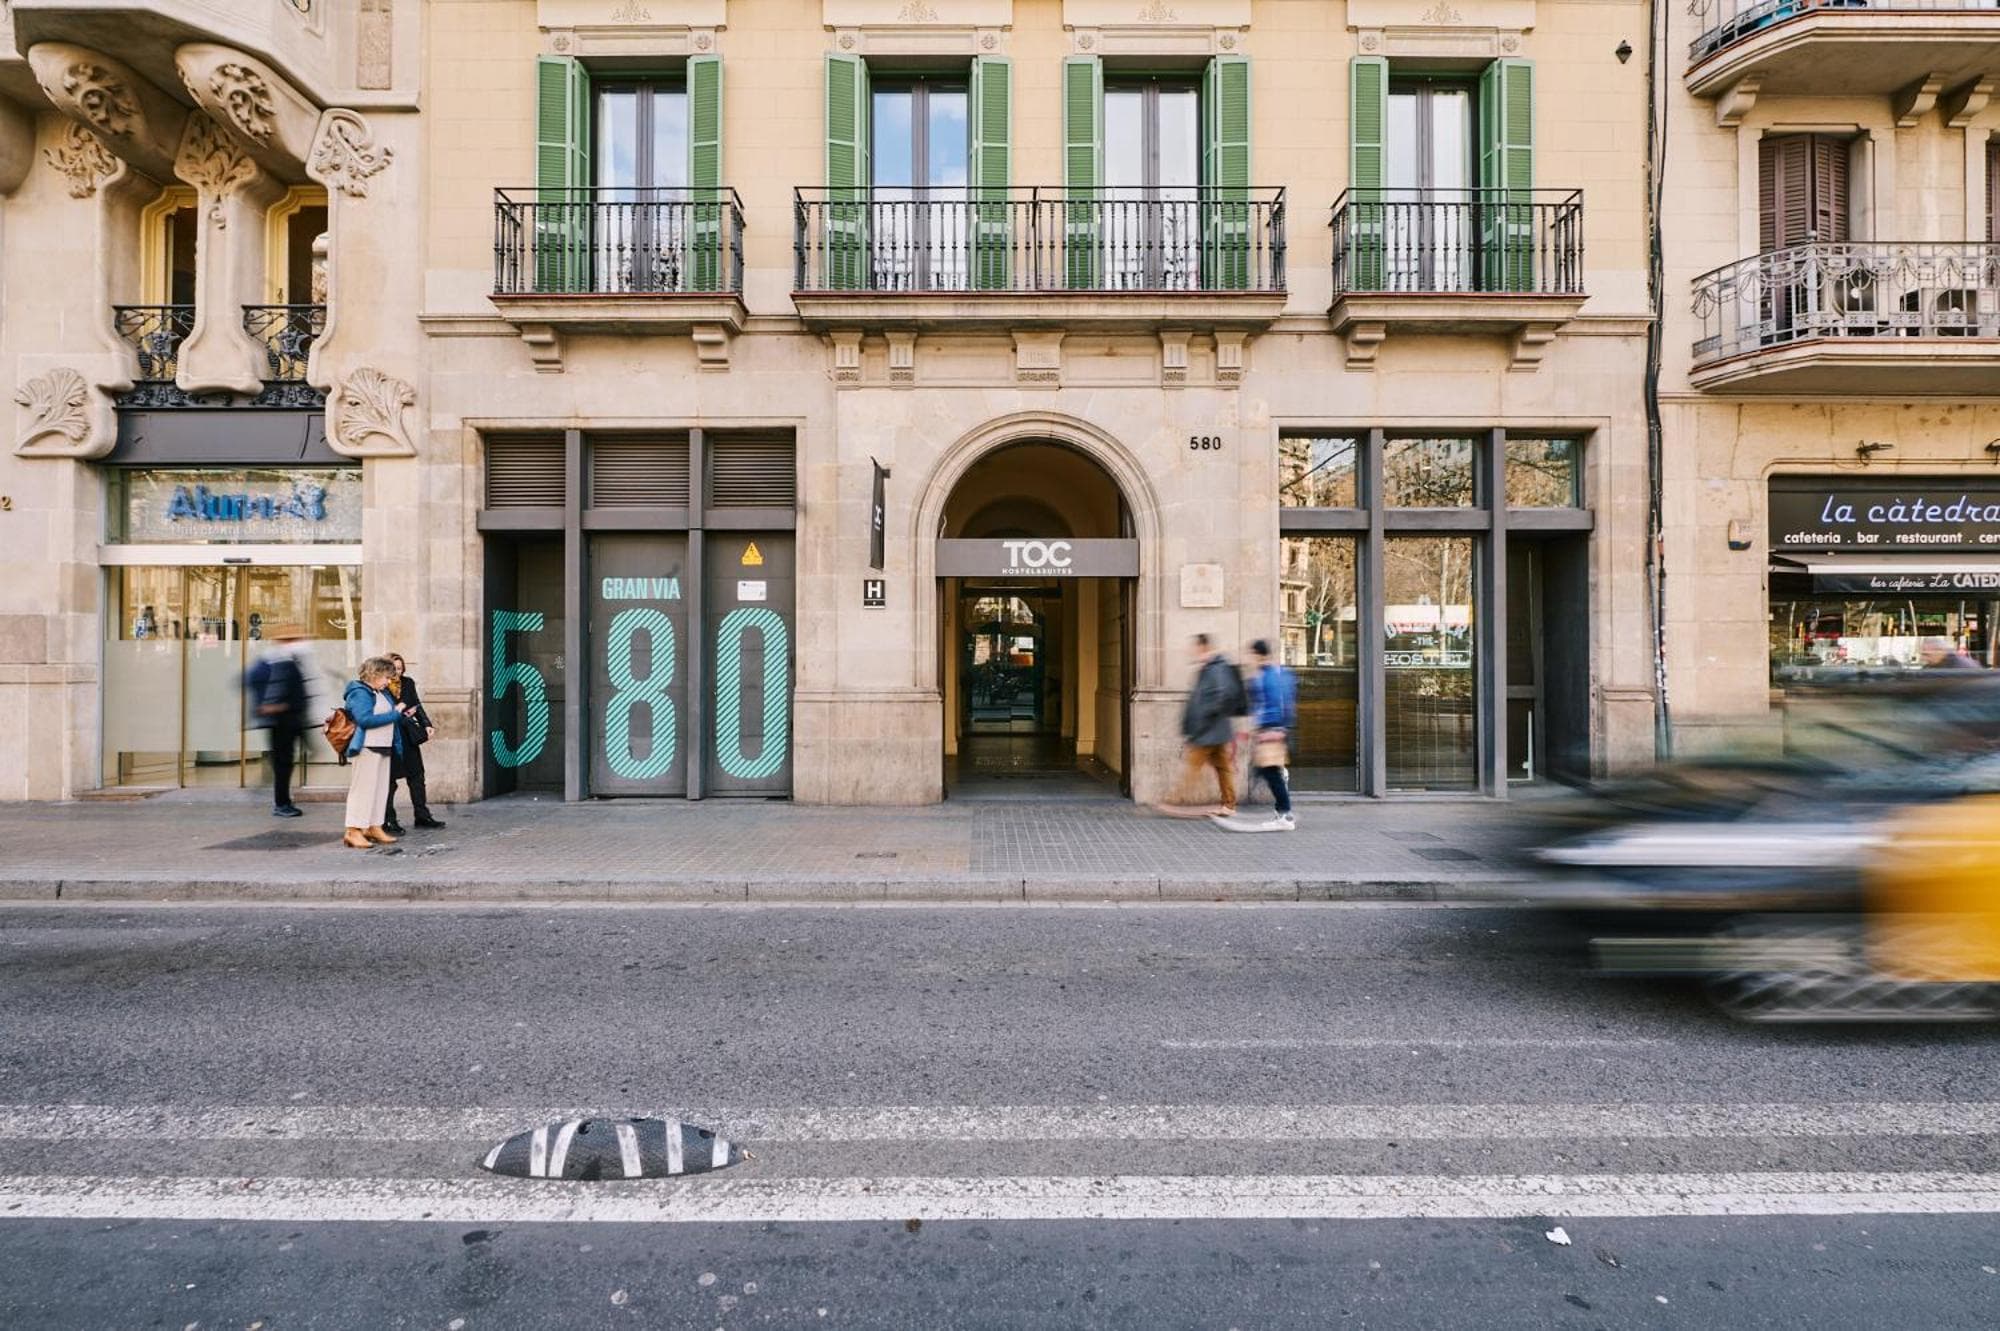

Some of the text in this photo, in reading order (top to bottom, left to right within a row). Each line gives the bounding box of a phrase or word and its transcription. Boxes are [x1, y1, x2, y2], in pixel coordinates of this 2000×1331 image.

[1190, 437, 1221, 450] 580
[1821, 495, 1856, 522] la
[1784, 531, 1841, 543] cafeteria
[1857, 532, 1880, 543] bar
[1895, 532, 1963, 543] restaurant
[1002, 541, 1072, 567] TOC
[602, 577, 681, 600] GRAN VIA
[1929, 573, 1950, 587] La
[867, 581, 881, 598] H
